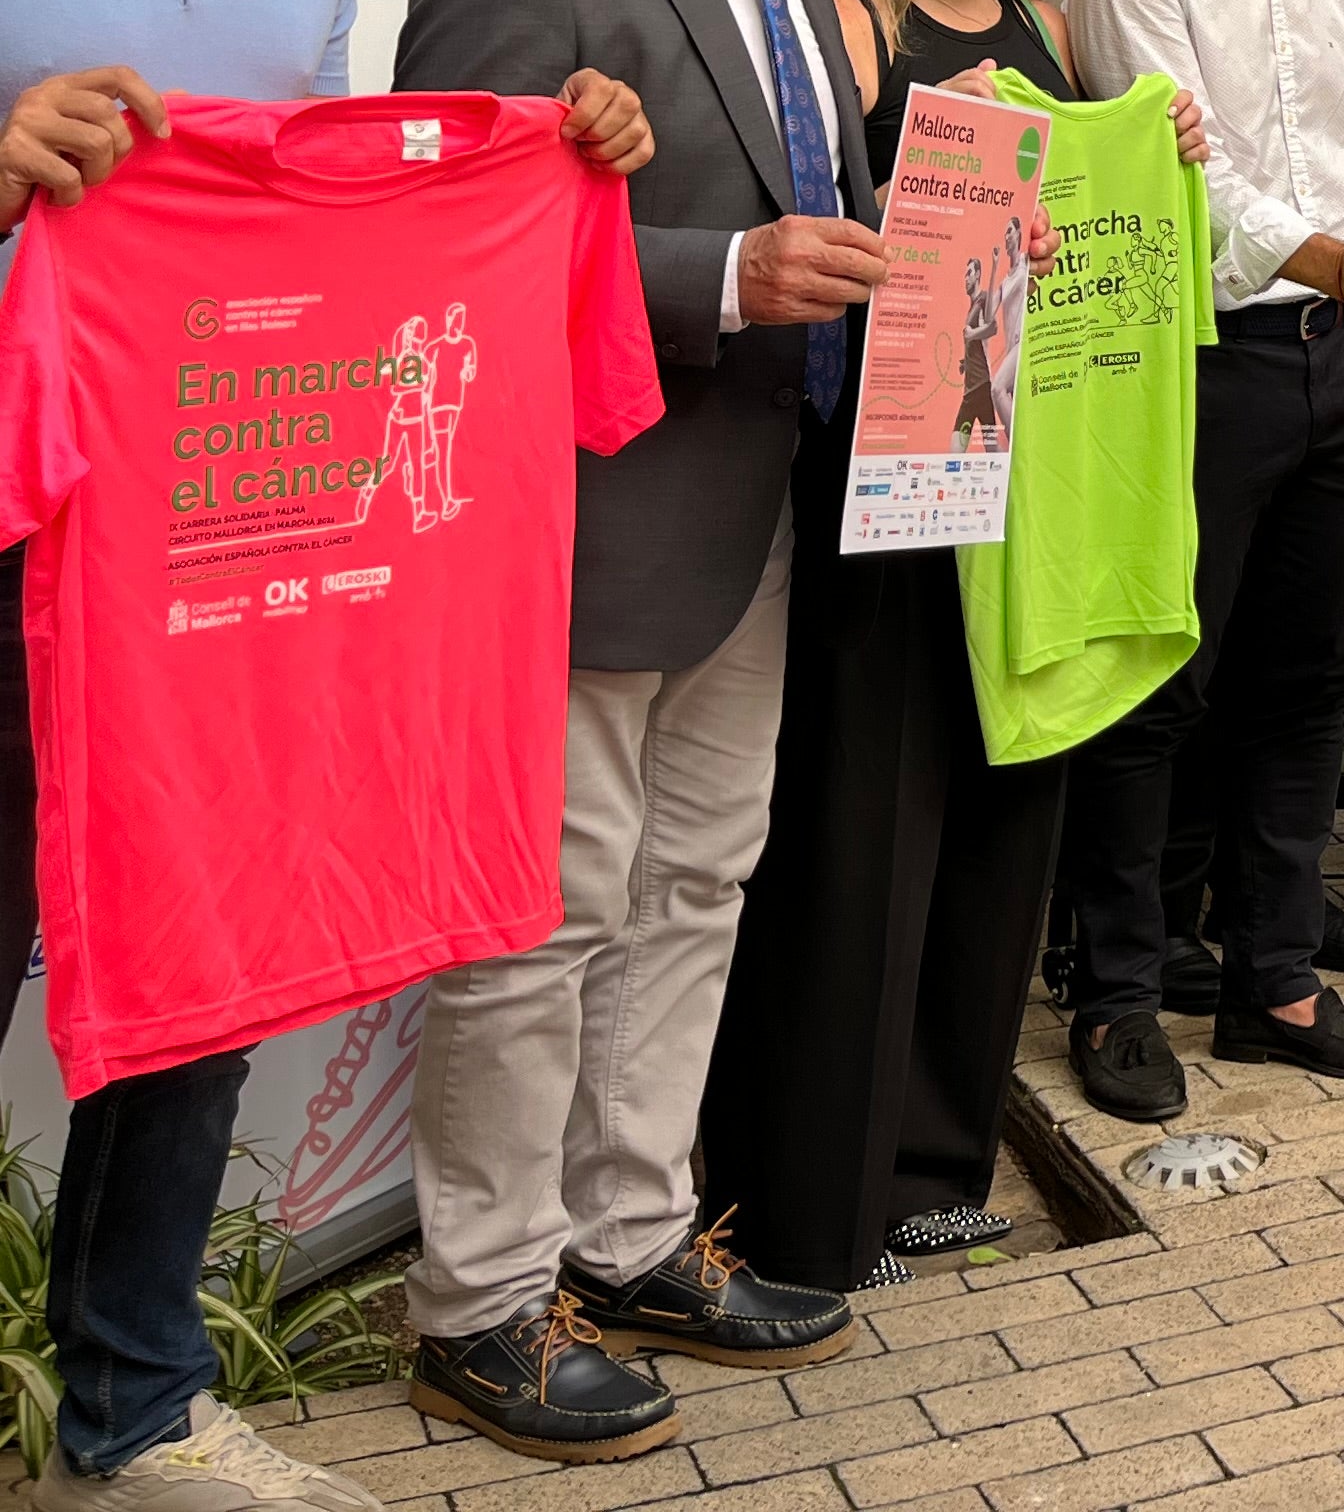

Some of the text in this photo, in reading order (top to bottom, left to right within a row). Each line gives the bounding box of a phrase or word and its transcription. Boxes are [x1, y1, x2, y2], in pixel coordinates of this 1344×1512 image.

[911, 112, 975, 144] Mallorca
[906, 146, 982, 174] en marcha
[901, 174, 1015, 207] contra el cáncer
[904, 245, 918, 263] de
[1027, 285, 1044, 315] el
[1101, 353, 1140, 365] EROSKI
[178, 345, 424, 407] En marcha
[1038, 371, 1066, 386] Consell
[173, 408, 331, 460] contra
[171, 454, 390, 512] el cáncer
[180, 515, 222, 529] CARRERA
[213, 523, 263, 539] MALLORCA
[264, 576, 309, 606] OK
[338, 569, 388, 587] EROSKI
